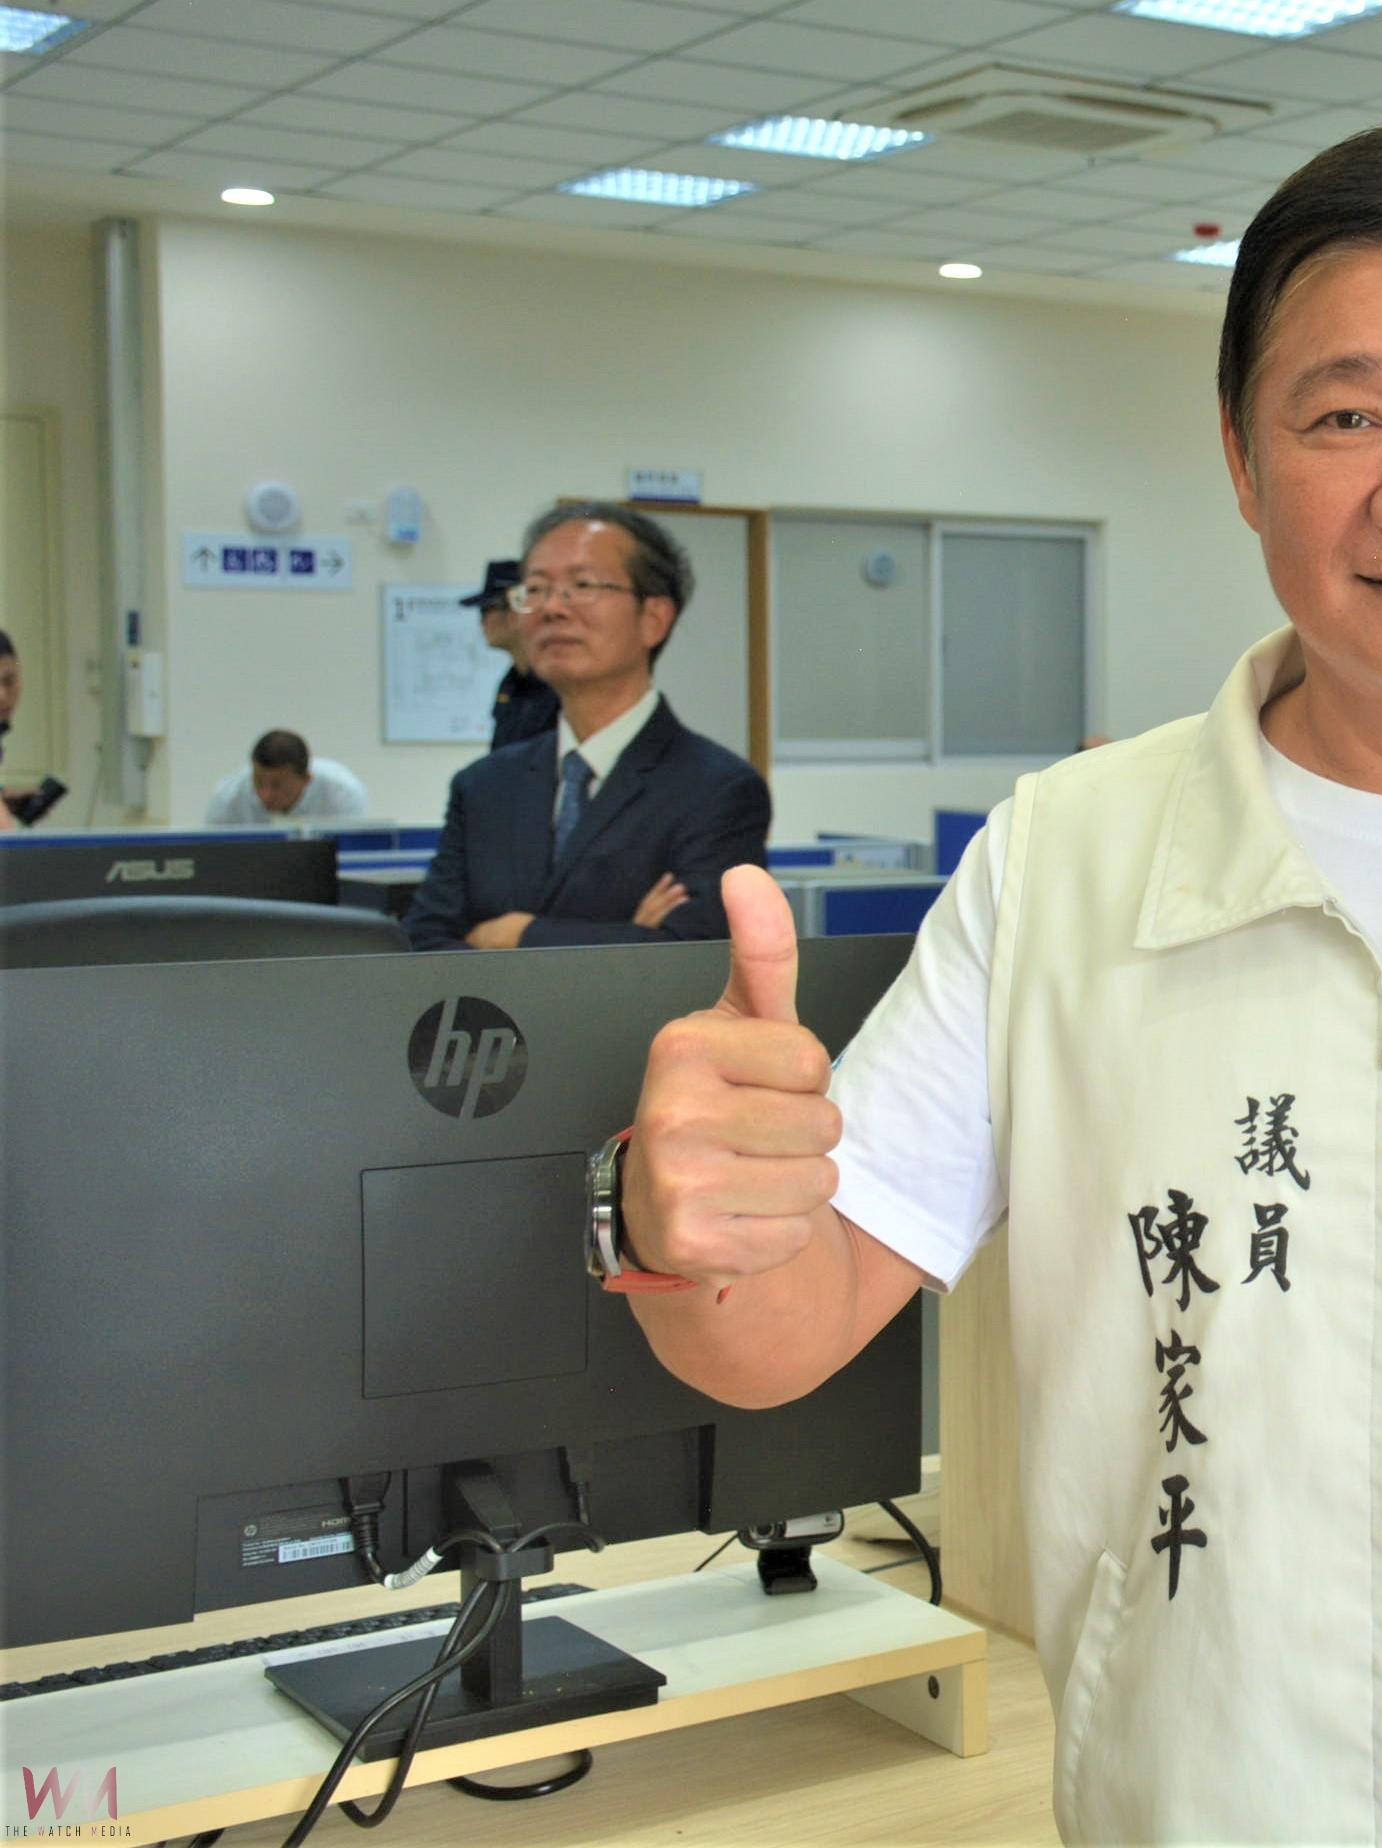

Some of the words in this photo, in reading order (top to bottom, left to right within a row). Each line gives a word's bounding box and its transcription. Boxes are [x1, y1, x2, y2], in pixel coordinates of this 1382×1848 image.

[104, 859, 195, 883] ASUS
[422, 996, 518, 1118] hp
[1233, 1093, 1311, 1292] 議員
[1128, 1188, 1221, 1601] 陳家平
